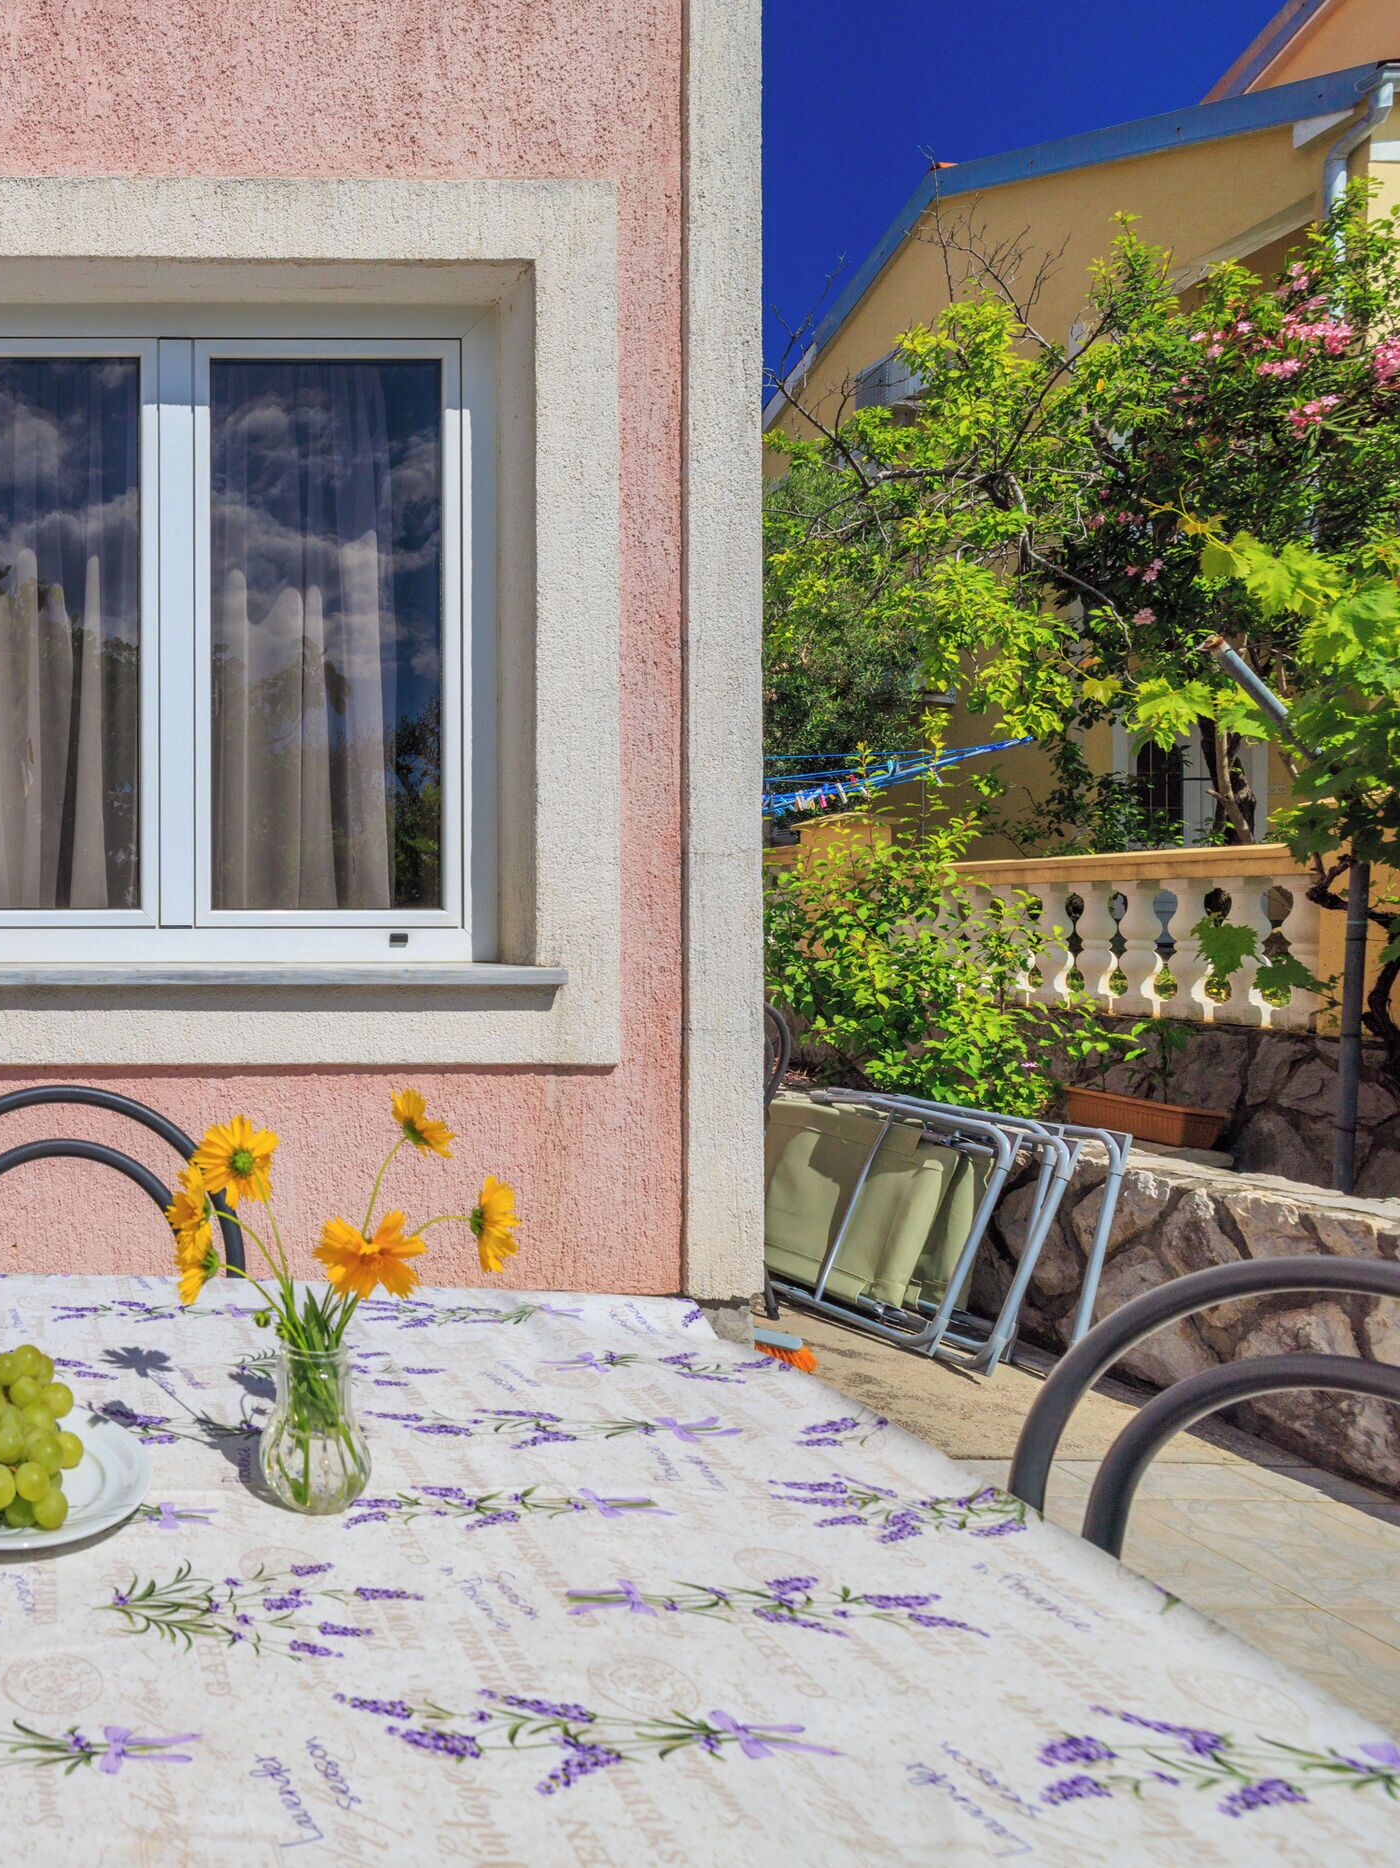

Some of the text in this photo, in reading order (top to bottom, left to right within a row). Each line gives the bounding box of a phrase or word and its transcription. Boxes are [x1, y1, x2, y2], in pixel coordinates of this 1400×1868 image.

[453, 1576, 511, 1631] Provence
[248, 1754, 323, 1848] Lavender
[900, 1762, 1032, 1856] Lavender
